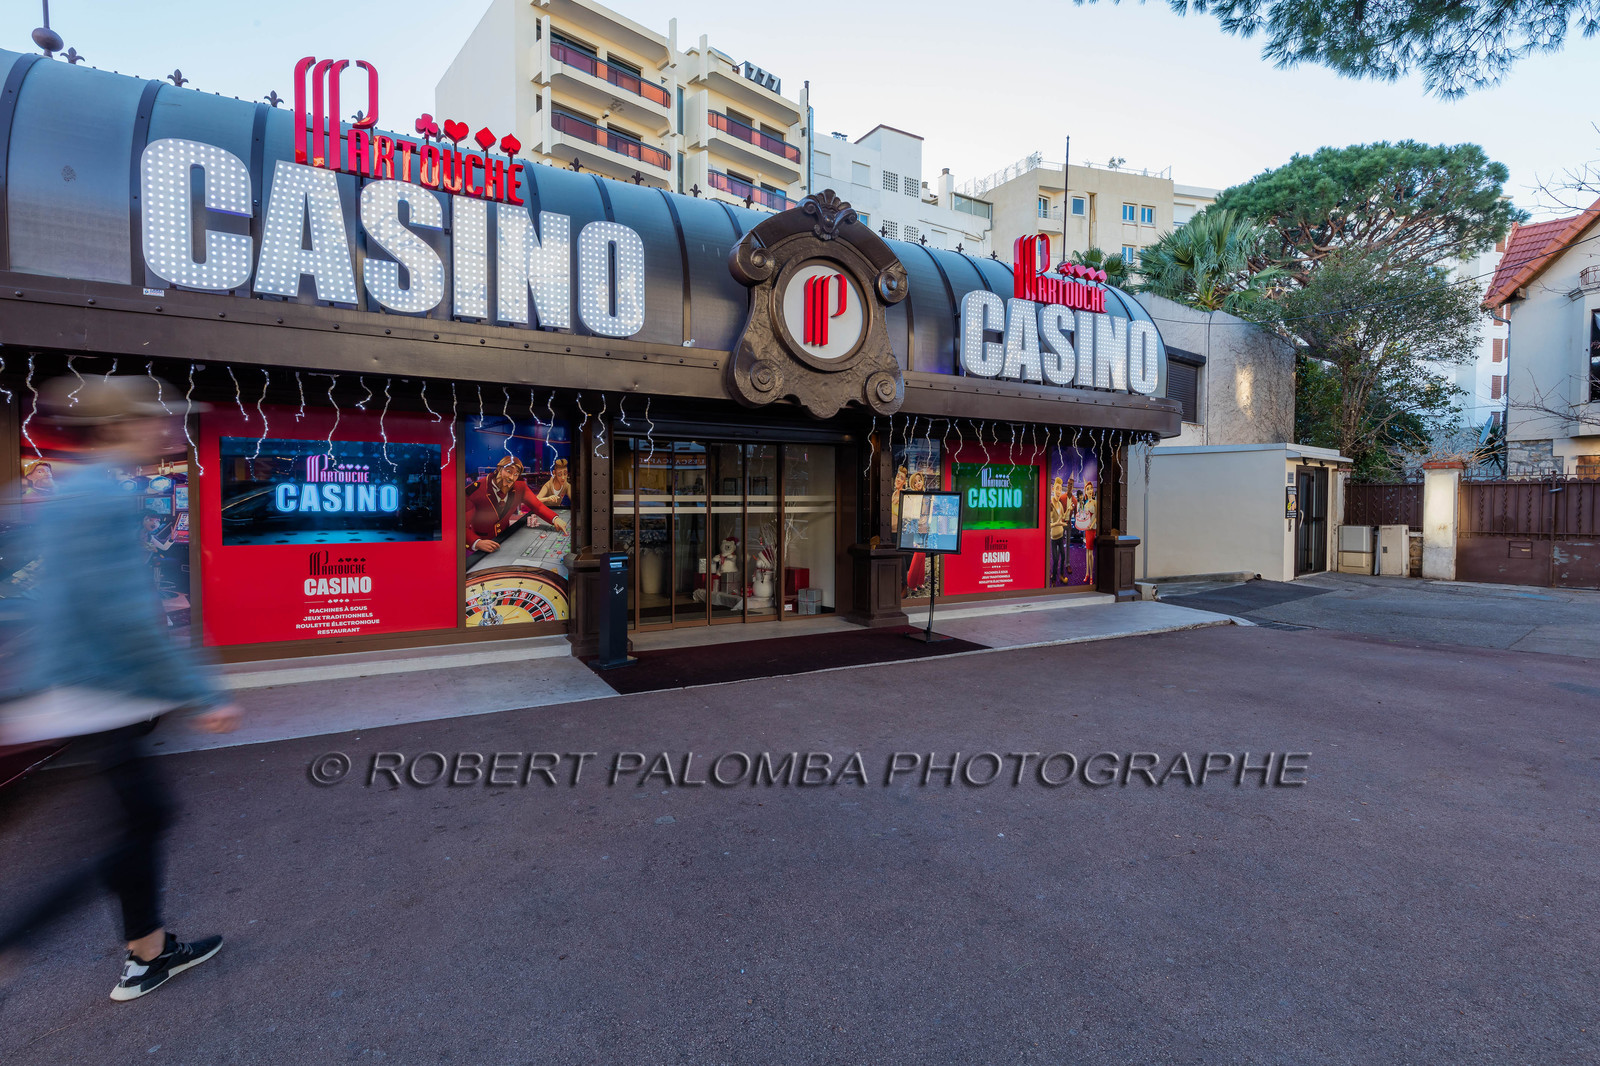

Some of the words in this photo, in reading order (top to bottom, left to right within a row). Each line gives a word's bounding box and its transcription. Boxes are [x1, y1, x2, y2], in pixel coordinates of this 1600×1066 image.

[748, 62, 780, 92] 777
[294, 56, 525, 205] PARTOUCHE
[140, 138, 645, 337] CASINO
[1014, 233, 1108, 314] PARTOUCHE
[960, 290, 1159, 395] CASINO
[306, 454, 370, 483] PARTOUCHE
[275, 482, 399, 512] CASINO
[968, 488, 1023, 508] CASINO
[309, 550, 367, 576] PARTOUCHE
[982, 551, 1010, 563] CASINO
[304, 576, 372, 596] CASINO
[322, 612, 373, 620] TRADITIONNELS
[331, 619, 380, 627] ÉLECTRONIQUE
[317, 627, 360, 635] RESTAURANT
